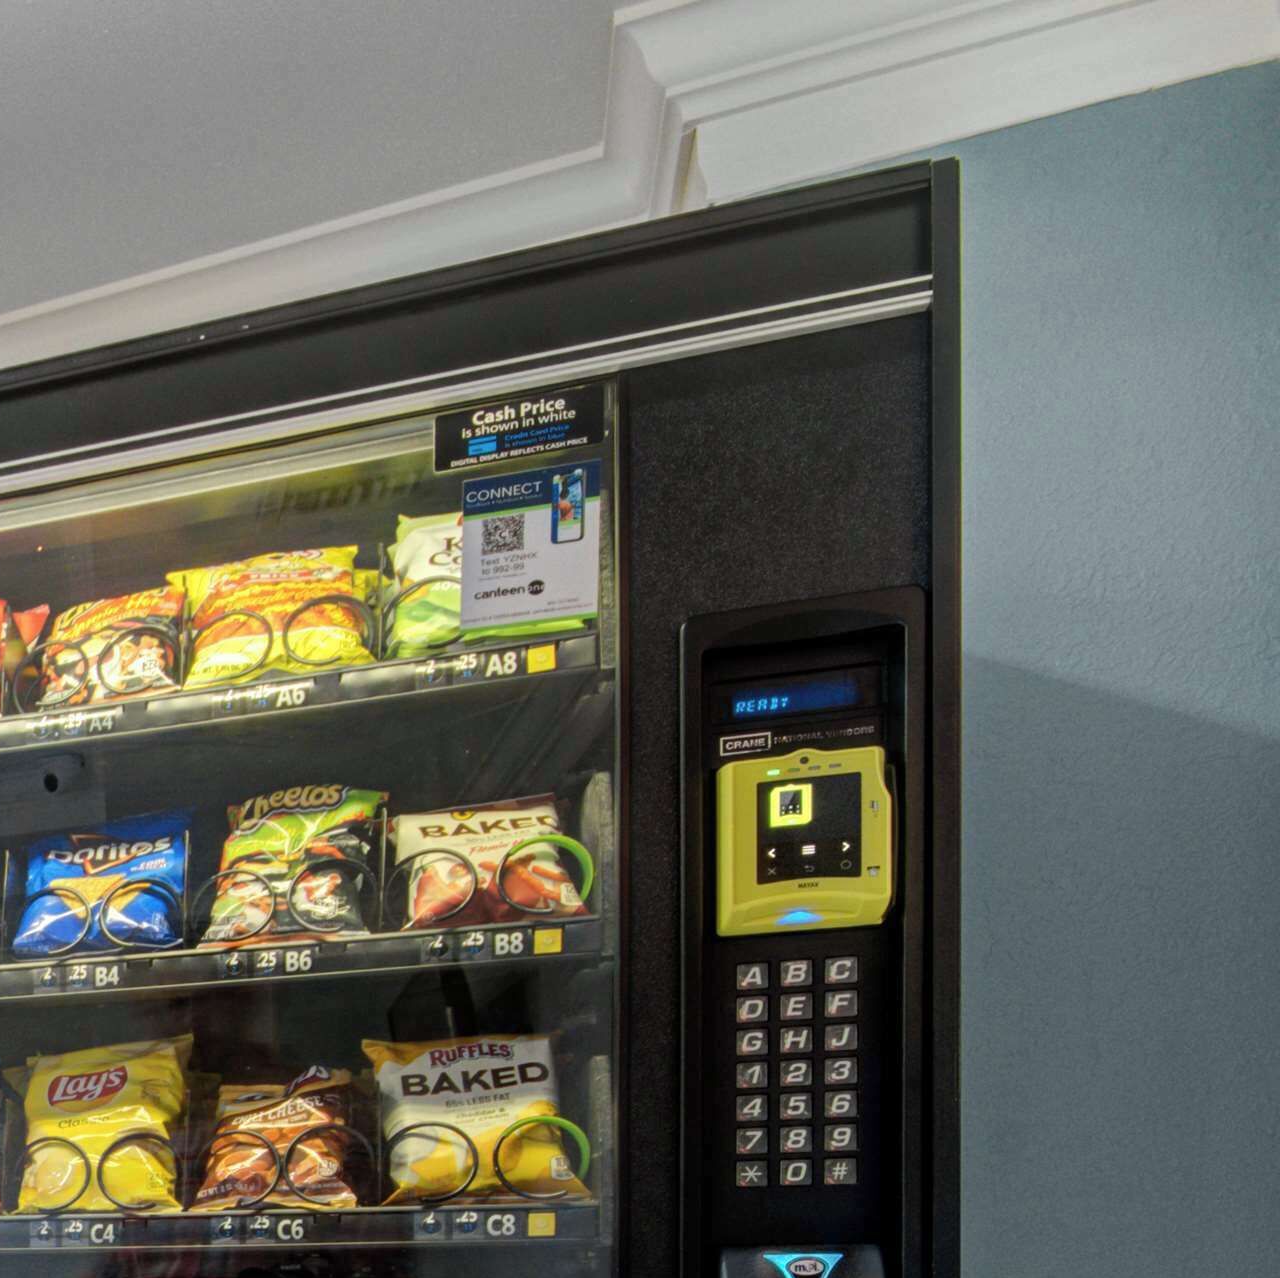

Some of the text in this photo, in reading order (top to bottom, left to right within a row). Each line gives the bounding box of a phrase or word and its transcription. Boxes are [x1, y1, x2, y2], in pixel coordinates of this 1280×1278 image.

[472, 398, 566, 426] Cash Price
[462, 409, 576, 439] is shown in white
[451, 436, 587, 468] DIGITAL DISPLAY REFLECTS CASH PRICE
[466, 480, 542, 503] CONNECT
[474, 586, 525, 600] canteen
[486, 651, 517, 678] A8
[276, 689, 305, 707] A6
[736, 697, 788, 714] READY
[726, 738, 766, 750] CRANE
[47, 836, 171, 864] Doritos
[495, 933, 523, 955] B8
[286, 951, 312, 971] B6
[95, 966, 119, 985] B4
[744, 961, 851, 985] A B C
[430, 1043, 512, 1068] RUFFLES
[50, 1066, 125, 1103] Lay's
[401, 1062, 549, 1096] BAKED
[493, 1093, 510, 1102] FAT
[743, 1094, 851, 1116] 4 5 6
[745, 1128, 851, 1149] 7 8 9
[90, 1223, 114, 1243] C4
[277, 1219, 303, 1239] C6
[487, 1214, 515, 1235] C8
